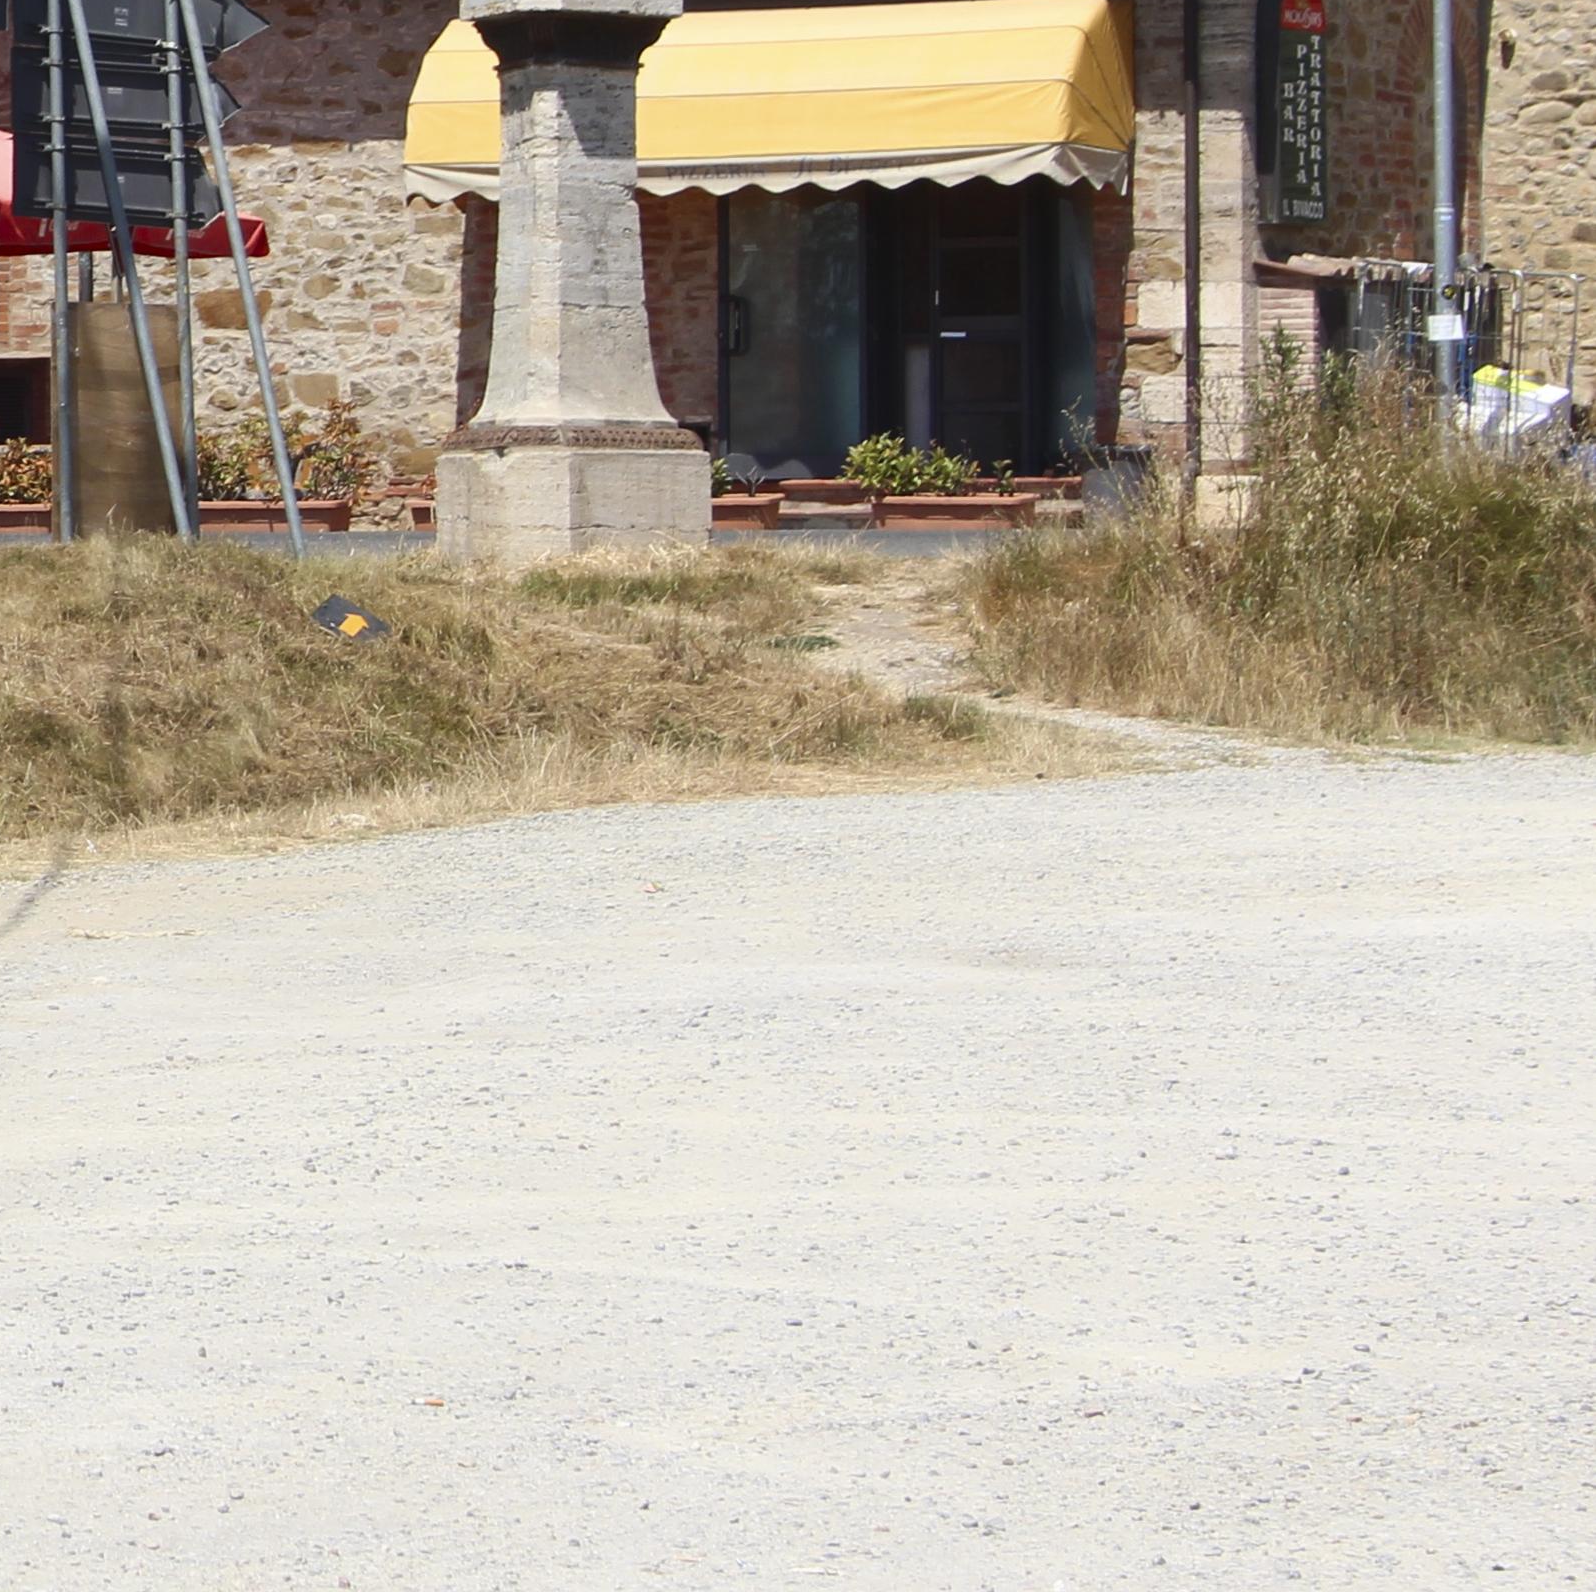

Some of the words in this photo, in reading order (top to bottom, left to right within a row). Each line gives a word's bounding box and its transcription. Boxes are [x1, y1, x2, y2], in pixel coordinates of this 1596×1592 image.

[1283, 82, 1295, 142] BAR
[1296, 44, 1307, 184] PIZZERIA
[1310, 35, 1322, 196] TRATTORIA
